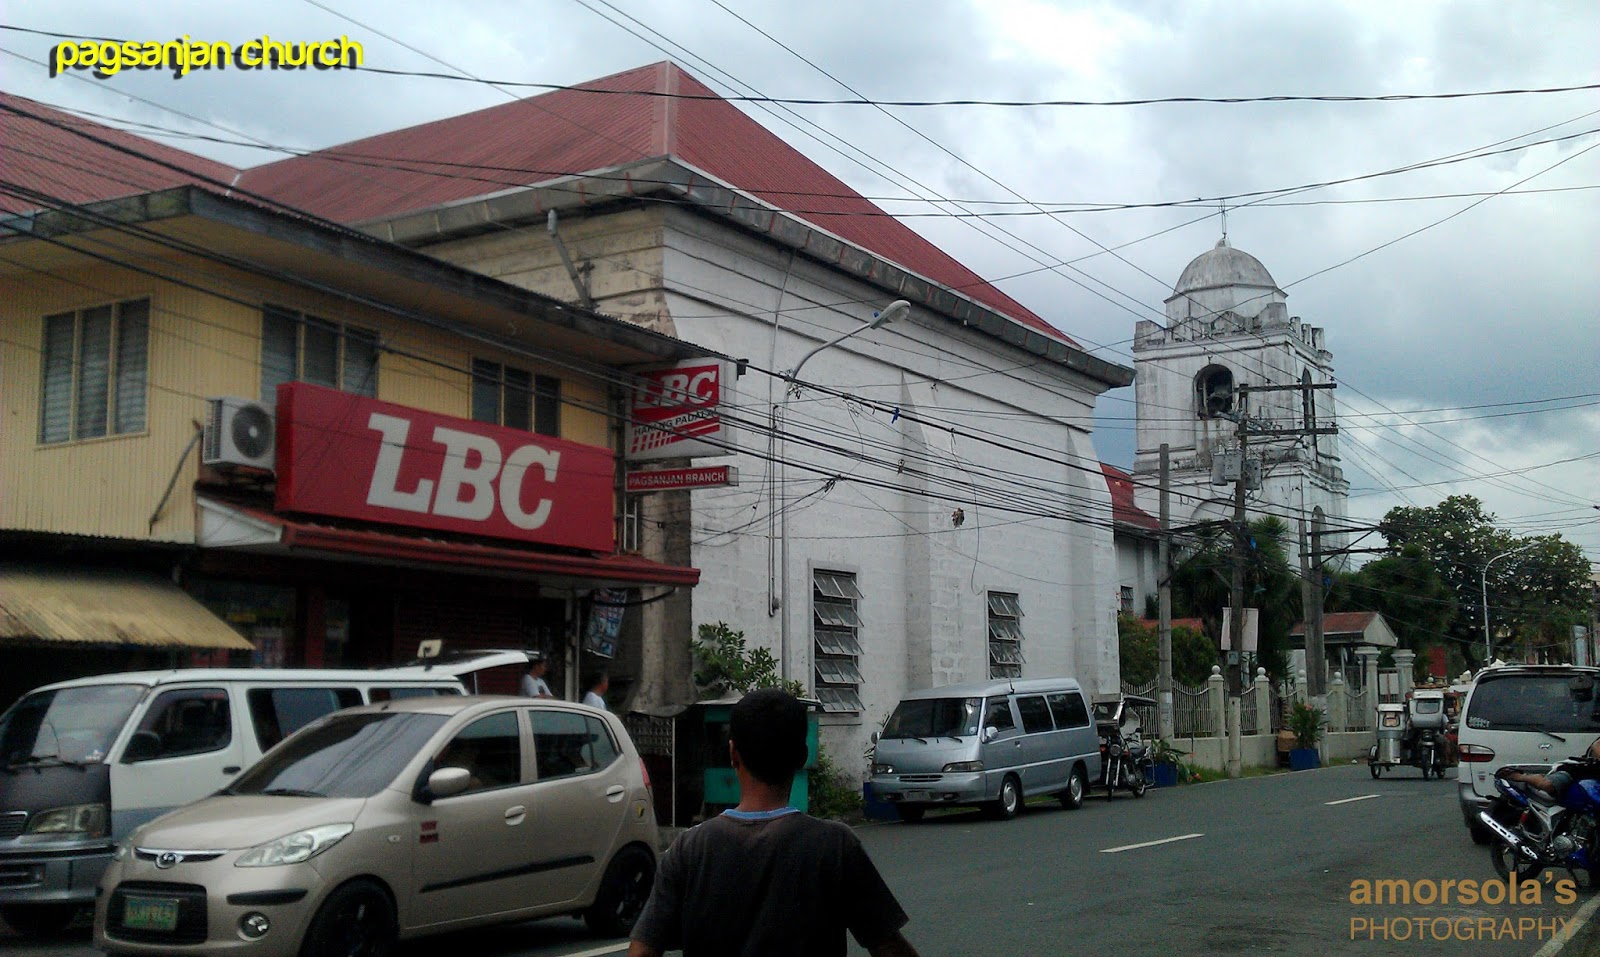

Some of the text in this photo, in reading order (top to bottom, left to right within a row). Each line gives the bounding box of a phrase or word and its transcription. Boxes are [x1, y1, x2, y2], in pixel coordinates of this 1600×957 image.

[632, 371, 717, 409] LBC
[366, 412, 561, 530] LBC
[628, 472, 725, 486] PAGSANJAN BRANCH
